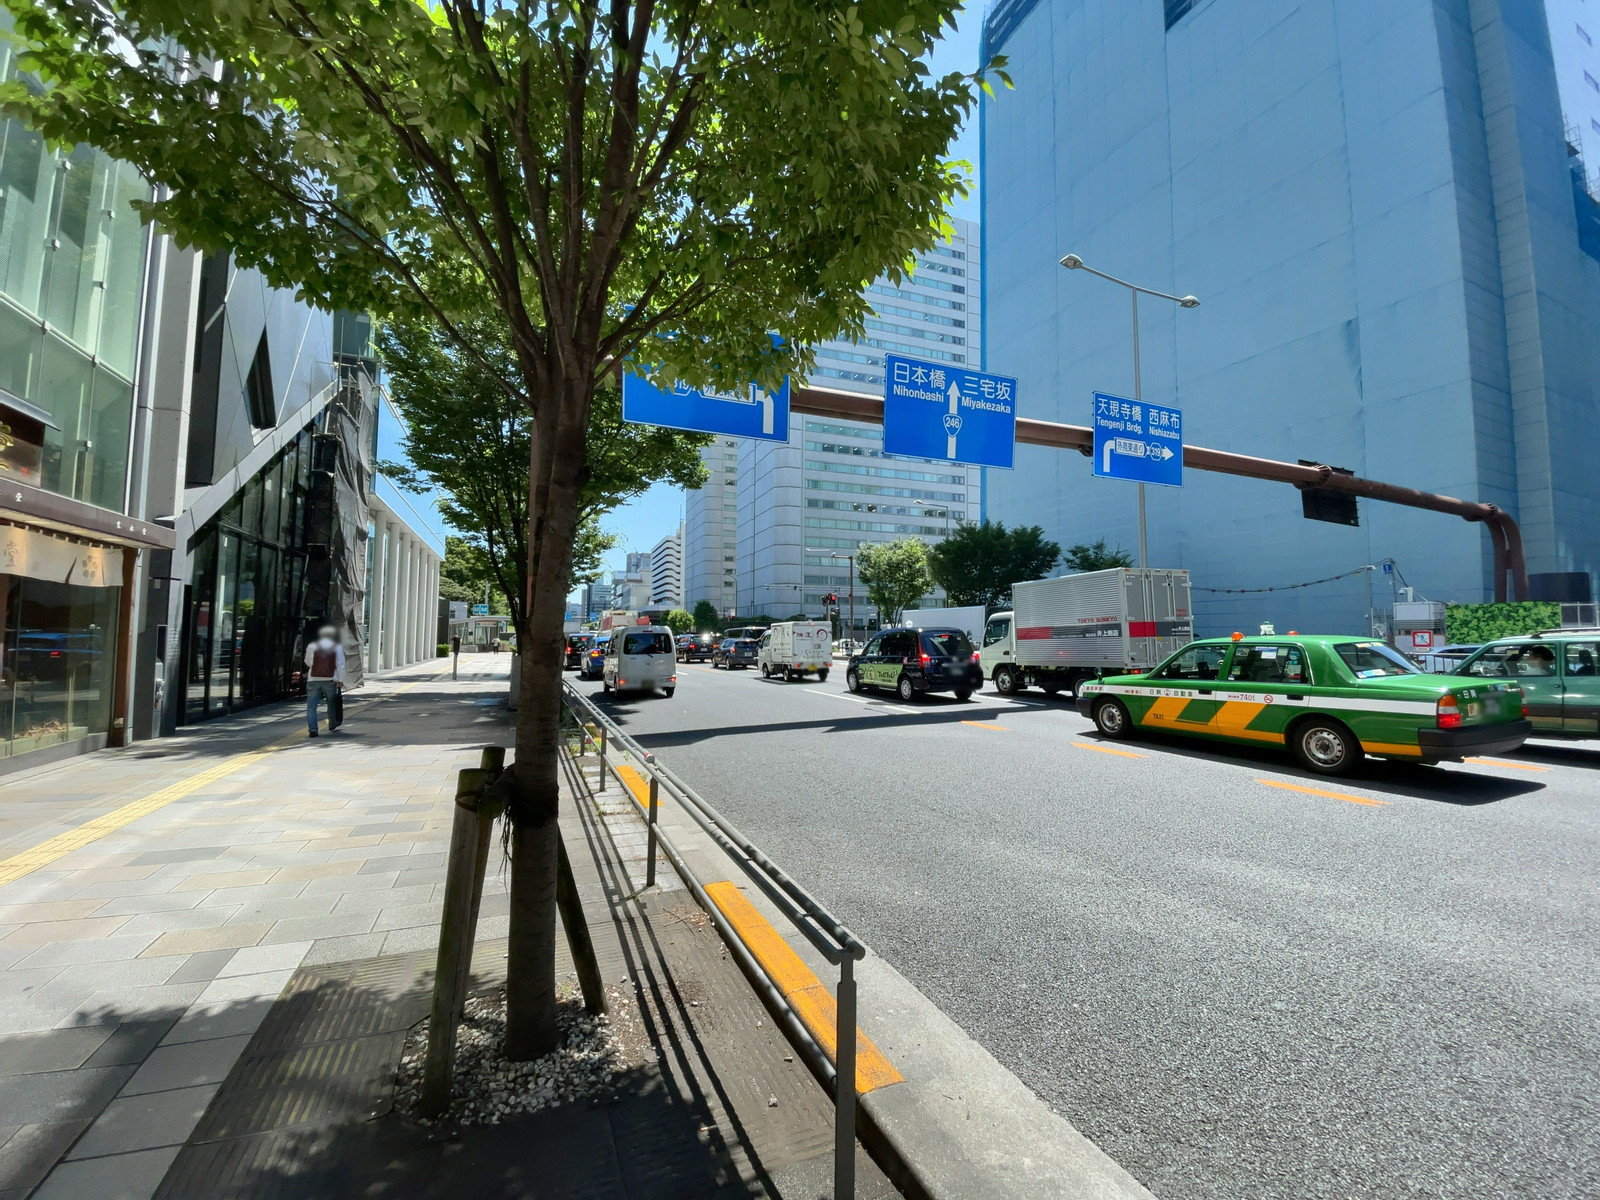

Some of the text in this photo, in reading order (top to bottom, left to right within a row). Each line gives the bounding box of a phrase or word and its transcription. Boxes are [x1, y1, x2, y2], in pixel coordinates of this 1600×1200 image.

[894, 362, 946, 390] 日本橋
[893, 384, 944, 402] Nihonbashi
[963, 376, 1011, 402] 三宅坂
[961, 396, 1011, 414] Miyakezaka
[1097, 398, 1142, 422] 天現寺橋
[946, 417, 960, 428] 246
[1096, 416, 1143, 434] Tengenji Brdg.
[1149, 408, 1180, 429] 西麻布
[1149, 426, 1180, 440] Nishiazabu
[1151, 447, 1160, 457] 319
[1240, 693, 1255, 701] 7401
